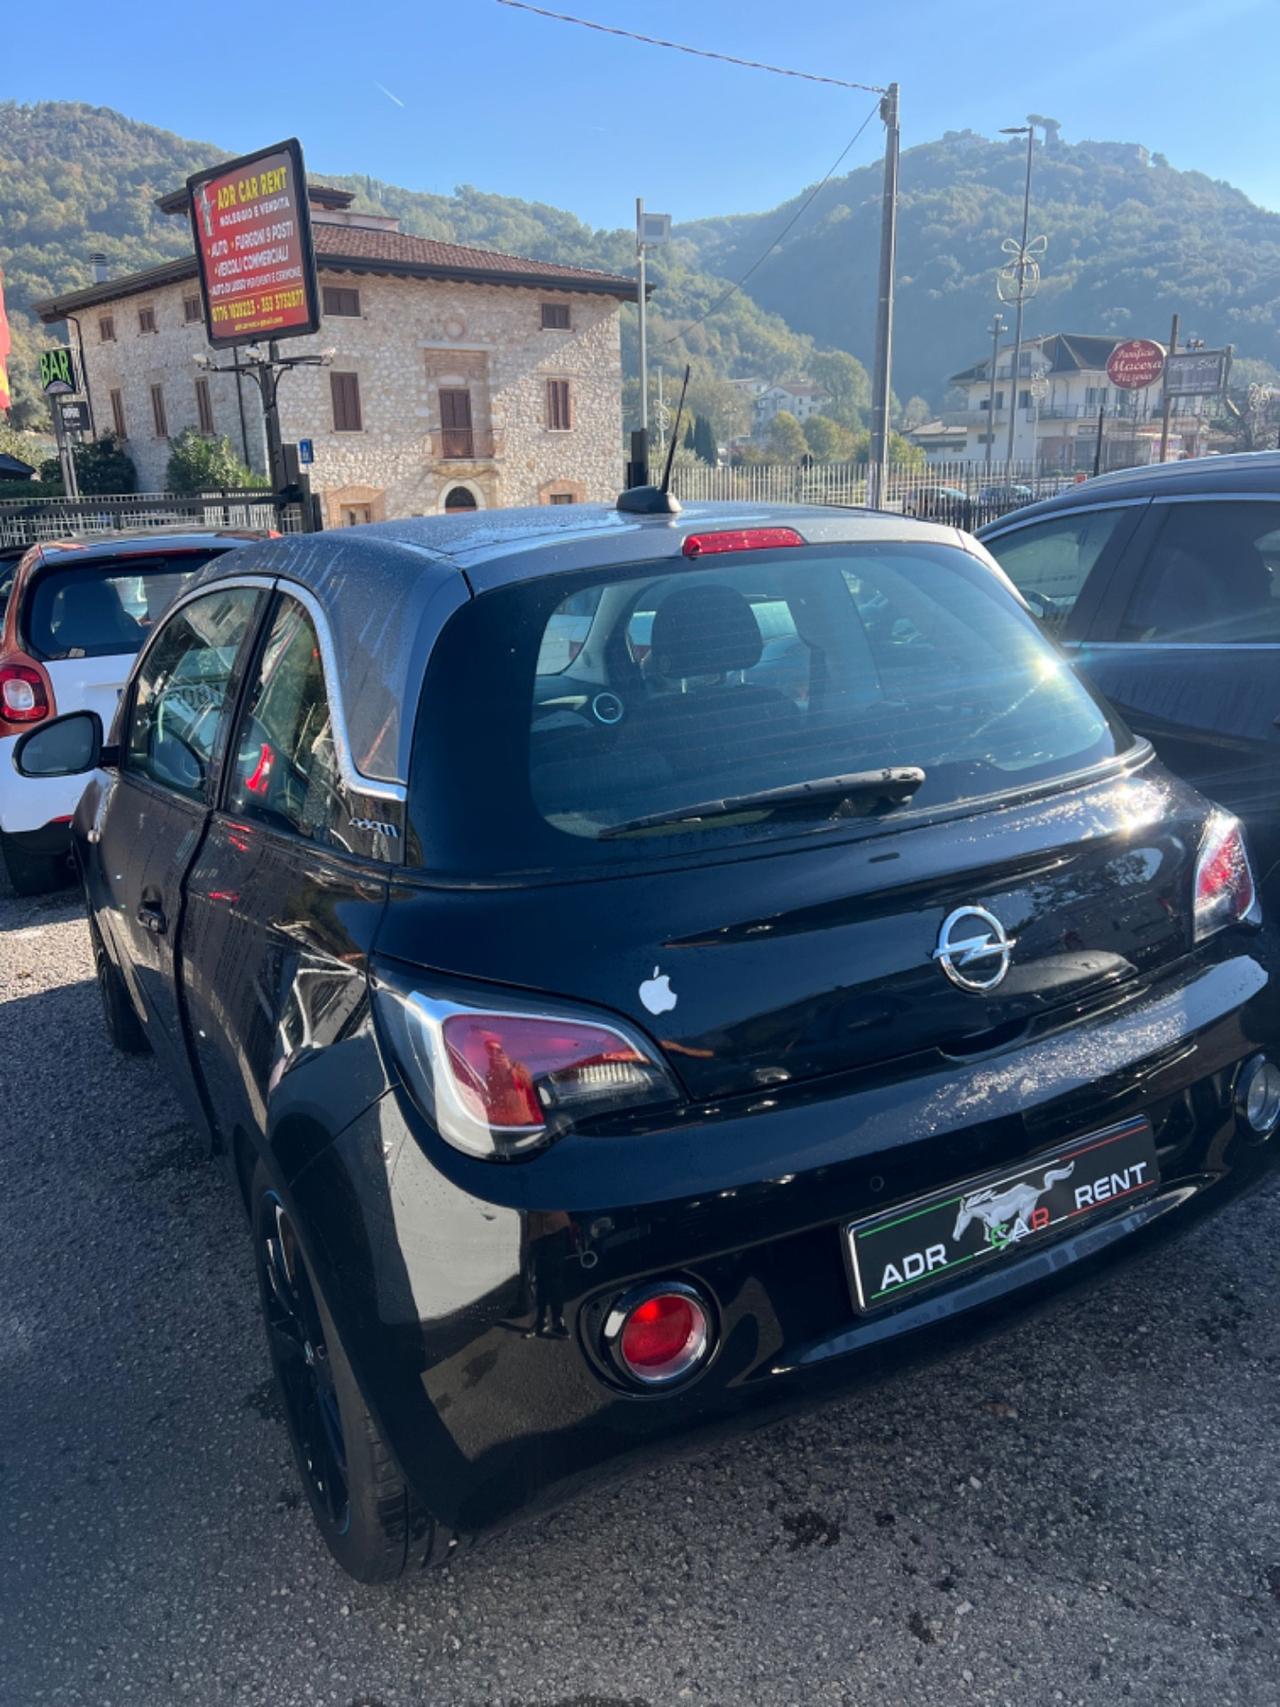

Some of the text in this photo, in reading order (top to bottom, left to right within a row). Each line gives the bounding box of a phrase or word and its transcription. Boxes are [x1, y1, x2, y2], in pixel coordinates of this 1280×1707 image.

[218, 166, 287, 209] ADR CAR RENT
[220, 197, 290, 226] NOLEGGIO E VENDITA
[212, 239, 228, 257] AUTO
[235, 229, 266, 251] FURGONI
[272, 221, 293, 241] POSTI
[218, 245, 289, 277] VEICOLI COMMERCIALI
[40, 350, 71, 390] BAR
[880, 1161, 1148, 1291] ADR CAR RENT
